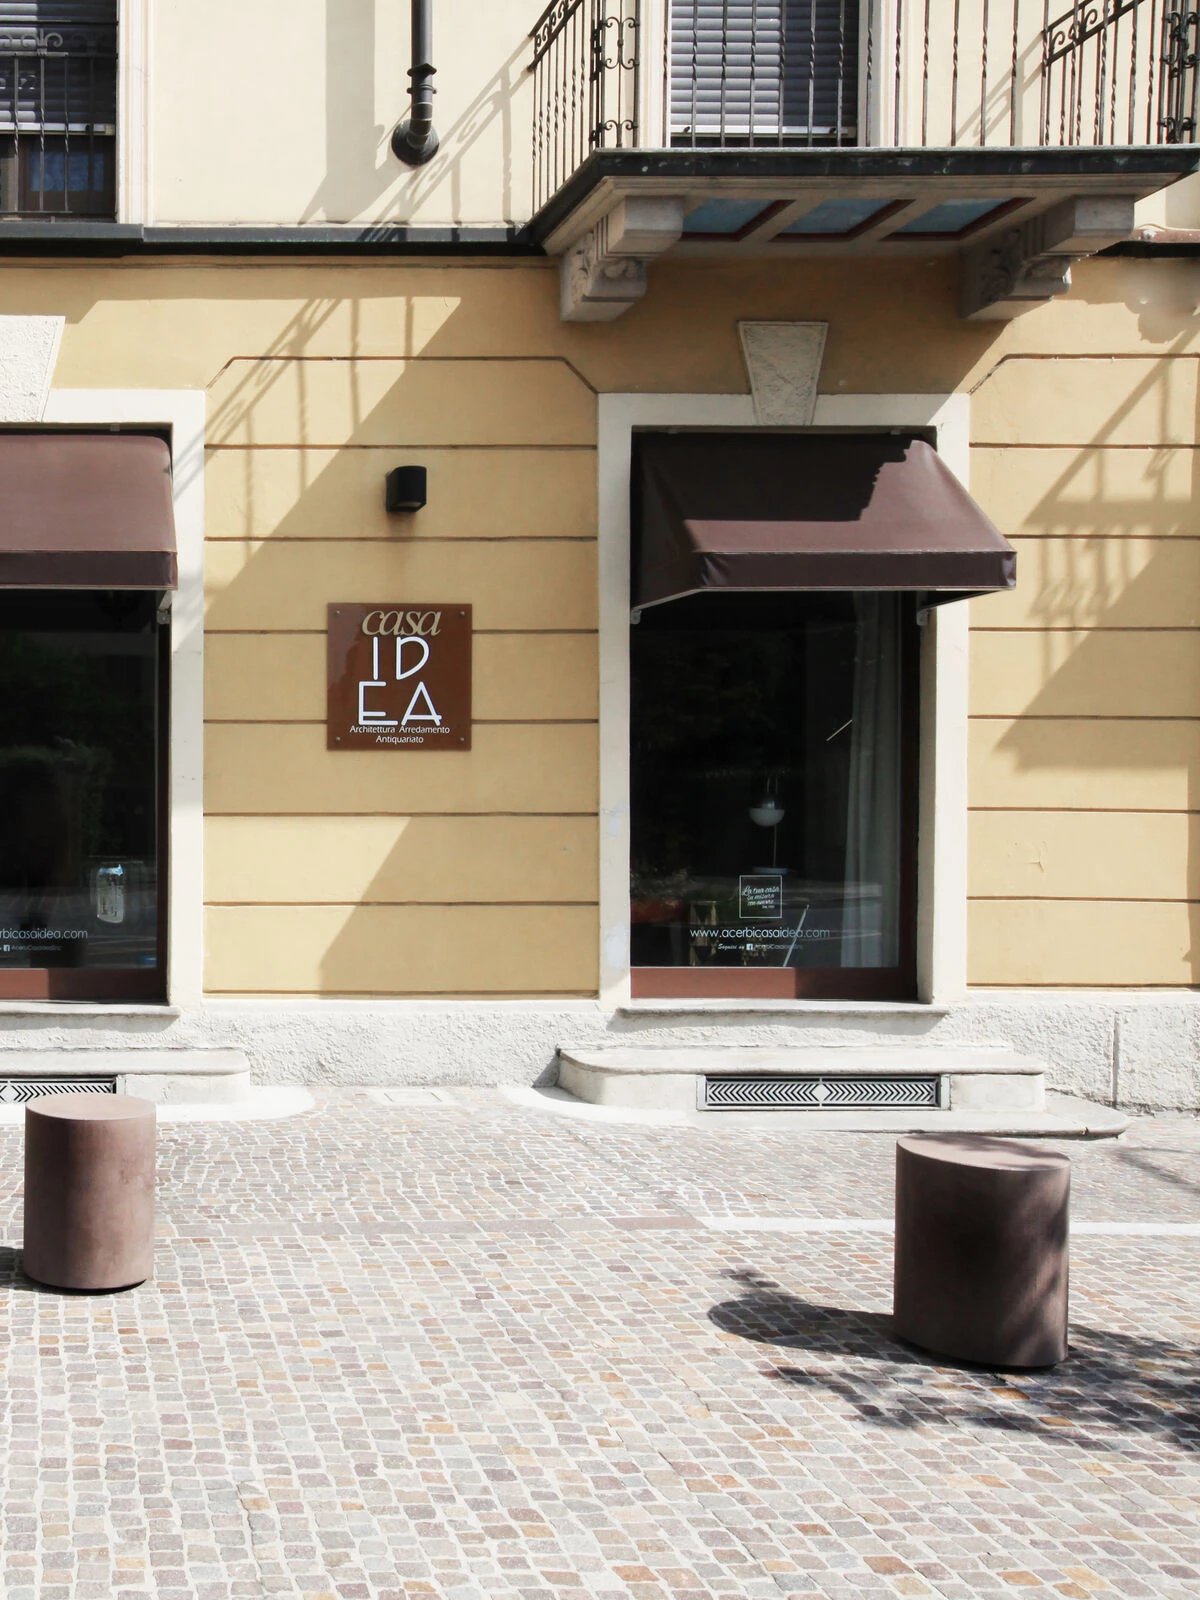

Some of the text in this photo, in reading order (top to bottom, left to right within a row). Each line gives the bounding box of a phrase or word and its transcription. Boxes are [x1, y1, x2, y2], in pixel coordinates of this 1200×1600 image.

[361, 610, 442, 636] casa
[349, 725, 451, 734] Architettura Arredamento
[375, 735, 424, 745] Antiquariato
[690, 926, 830, 938] www.acerbicasaidea.com
